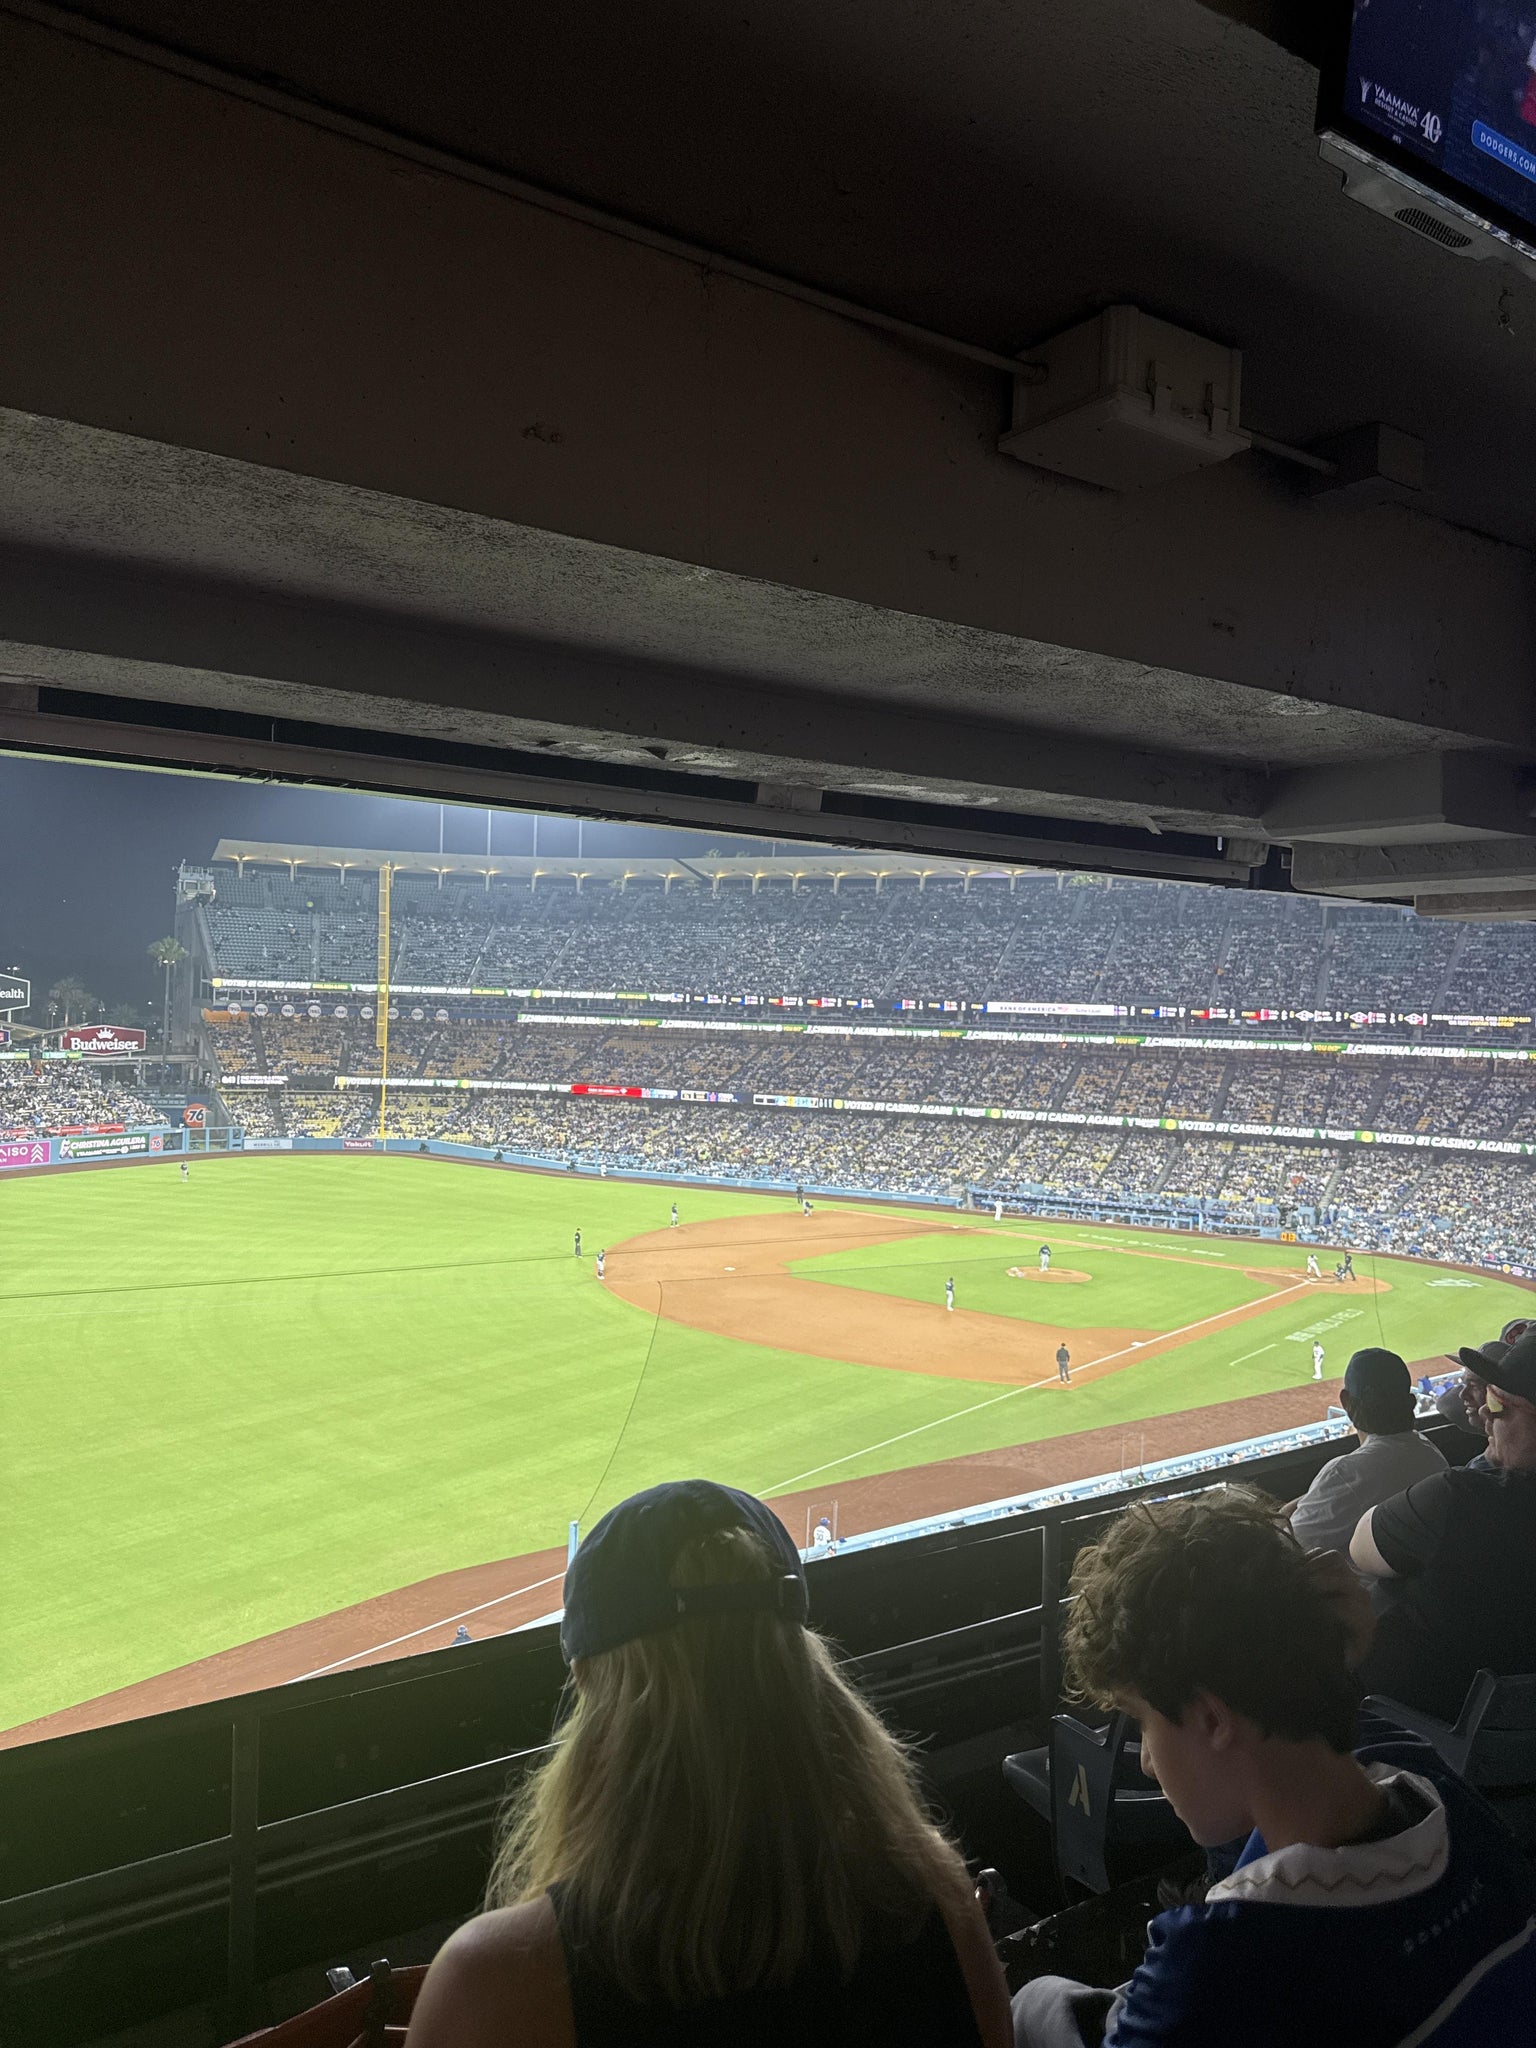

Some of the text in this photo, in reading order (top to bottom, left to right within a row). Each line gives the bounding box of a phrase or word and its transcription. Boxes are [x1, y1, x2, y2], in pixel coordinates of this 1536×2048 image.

[1480, 132, 1536, 175] DODGERS.COM
[1355, 1044, 1410, 1055] CHRISTINA
[1411, 1046, 1466, 1058] AGUILERA
[189, 1109, 204, 1122] 76
[1002, 1110, 1034, 1120] VOTED
[1048, 1112, 1086, 1124] CASINO
[1178, 1121, 1215, 1132] VOTED
[1230, 1124, 1272, 1136] CASINO
[71, 1137, 145, 1149] CHRISTINA AGUILERA
[1375, 1133, 1415, 1144] VOTED
[1416, 1135, 1430, 1146] #1
[1431, 1137, 1477, 1150] CASINO
[1068, 1764, 1091, 1817] A
